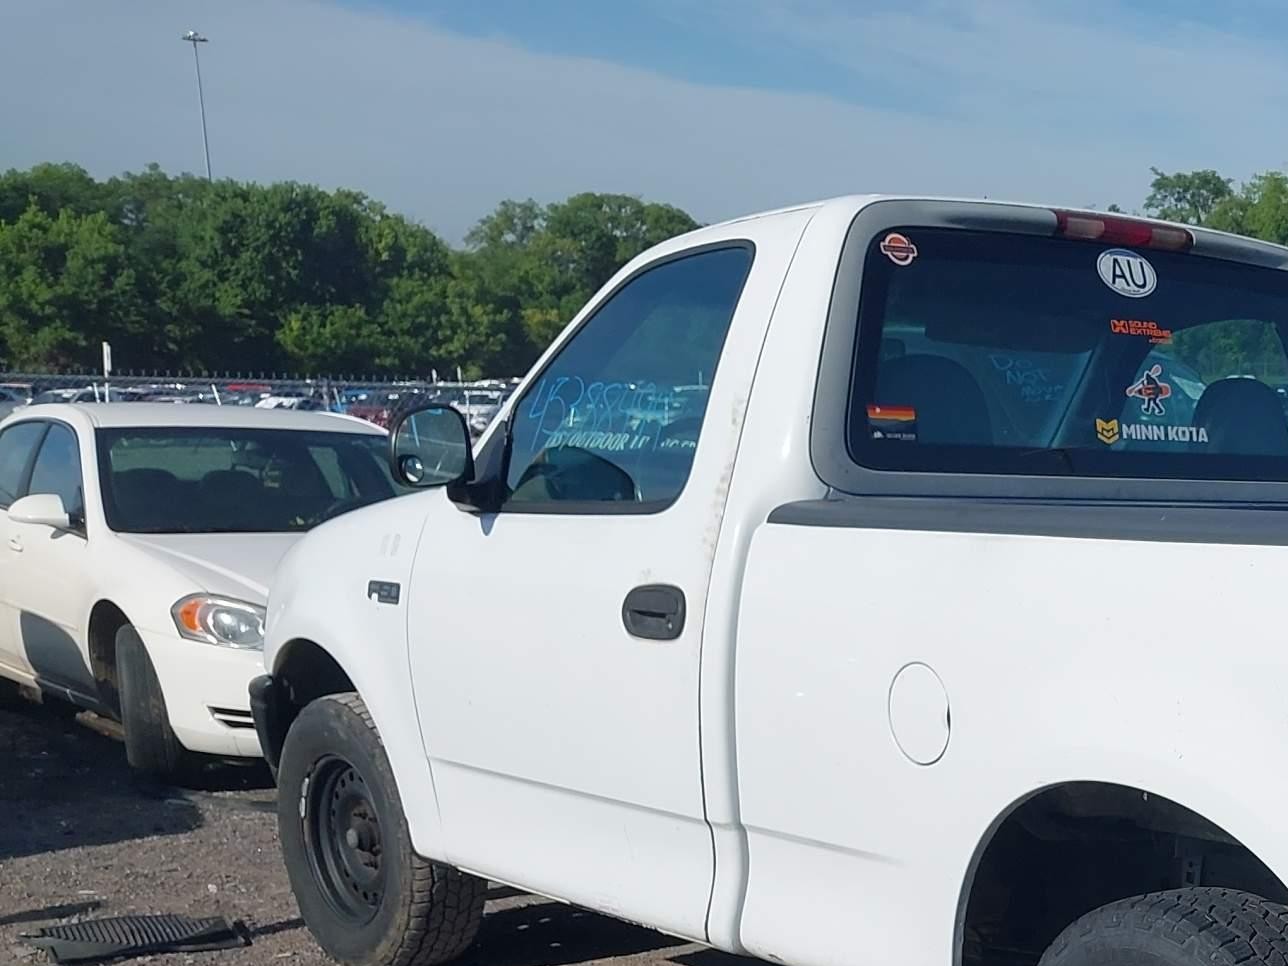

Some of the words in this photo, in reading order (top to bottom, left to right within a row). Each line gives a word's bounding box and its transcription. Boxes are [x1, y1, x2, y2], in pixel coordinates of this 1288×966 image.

[1111, 257, 1148, 289] AU
[1121, 423, 1165, 441] MINN
[1167, 425, 1209, 443] KOTA
